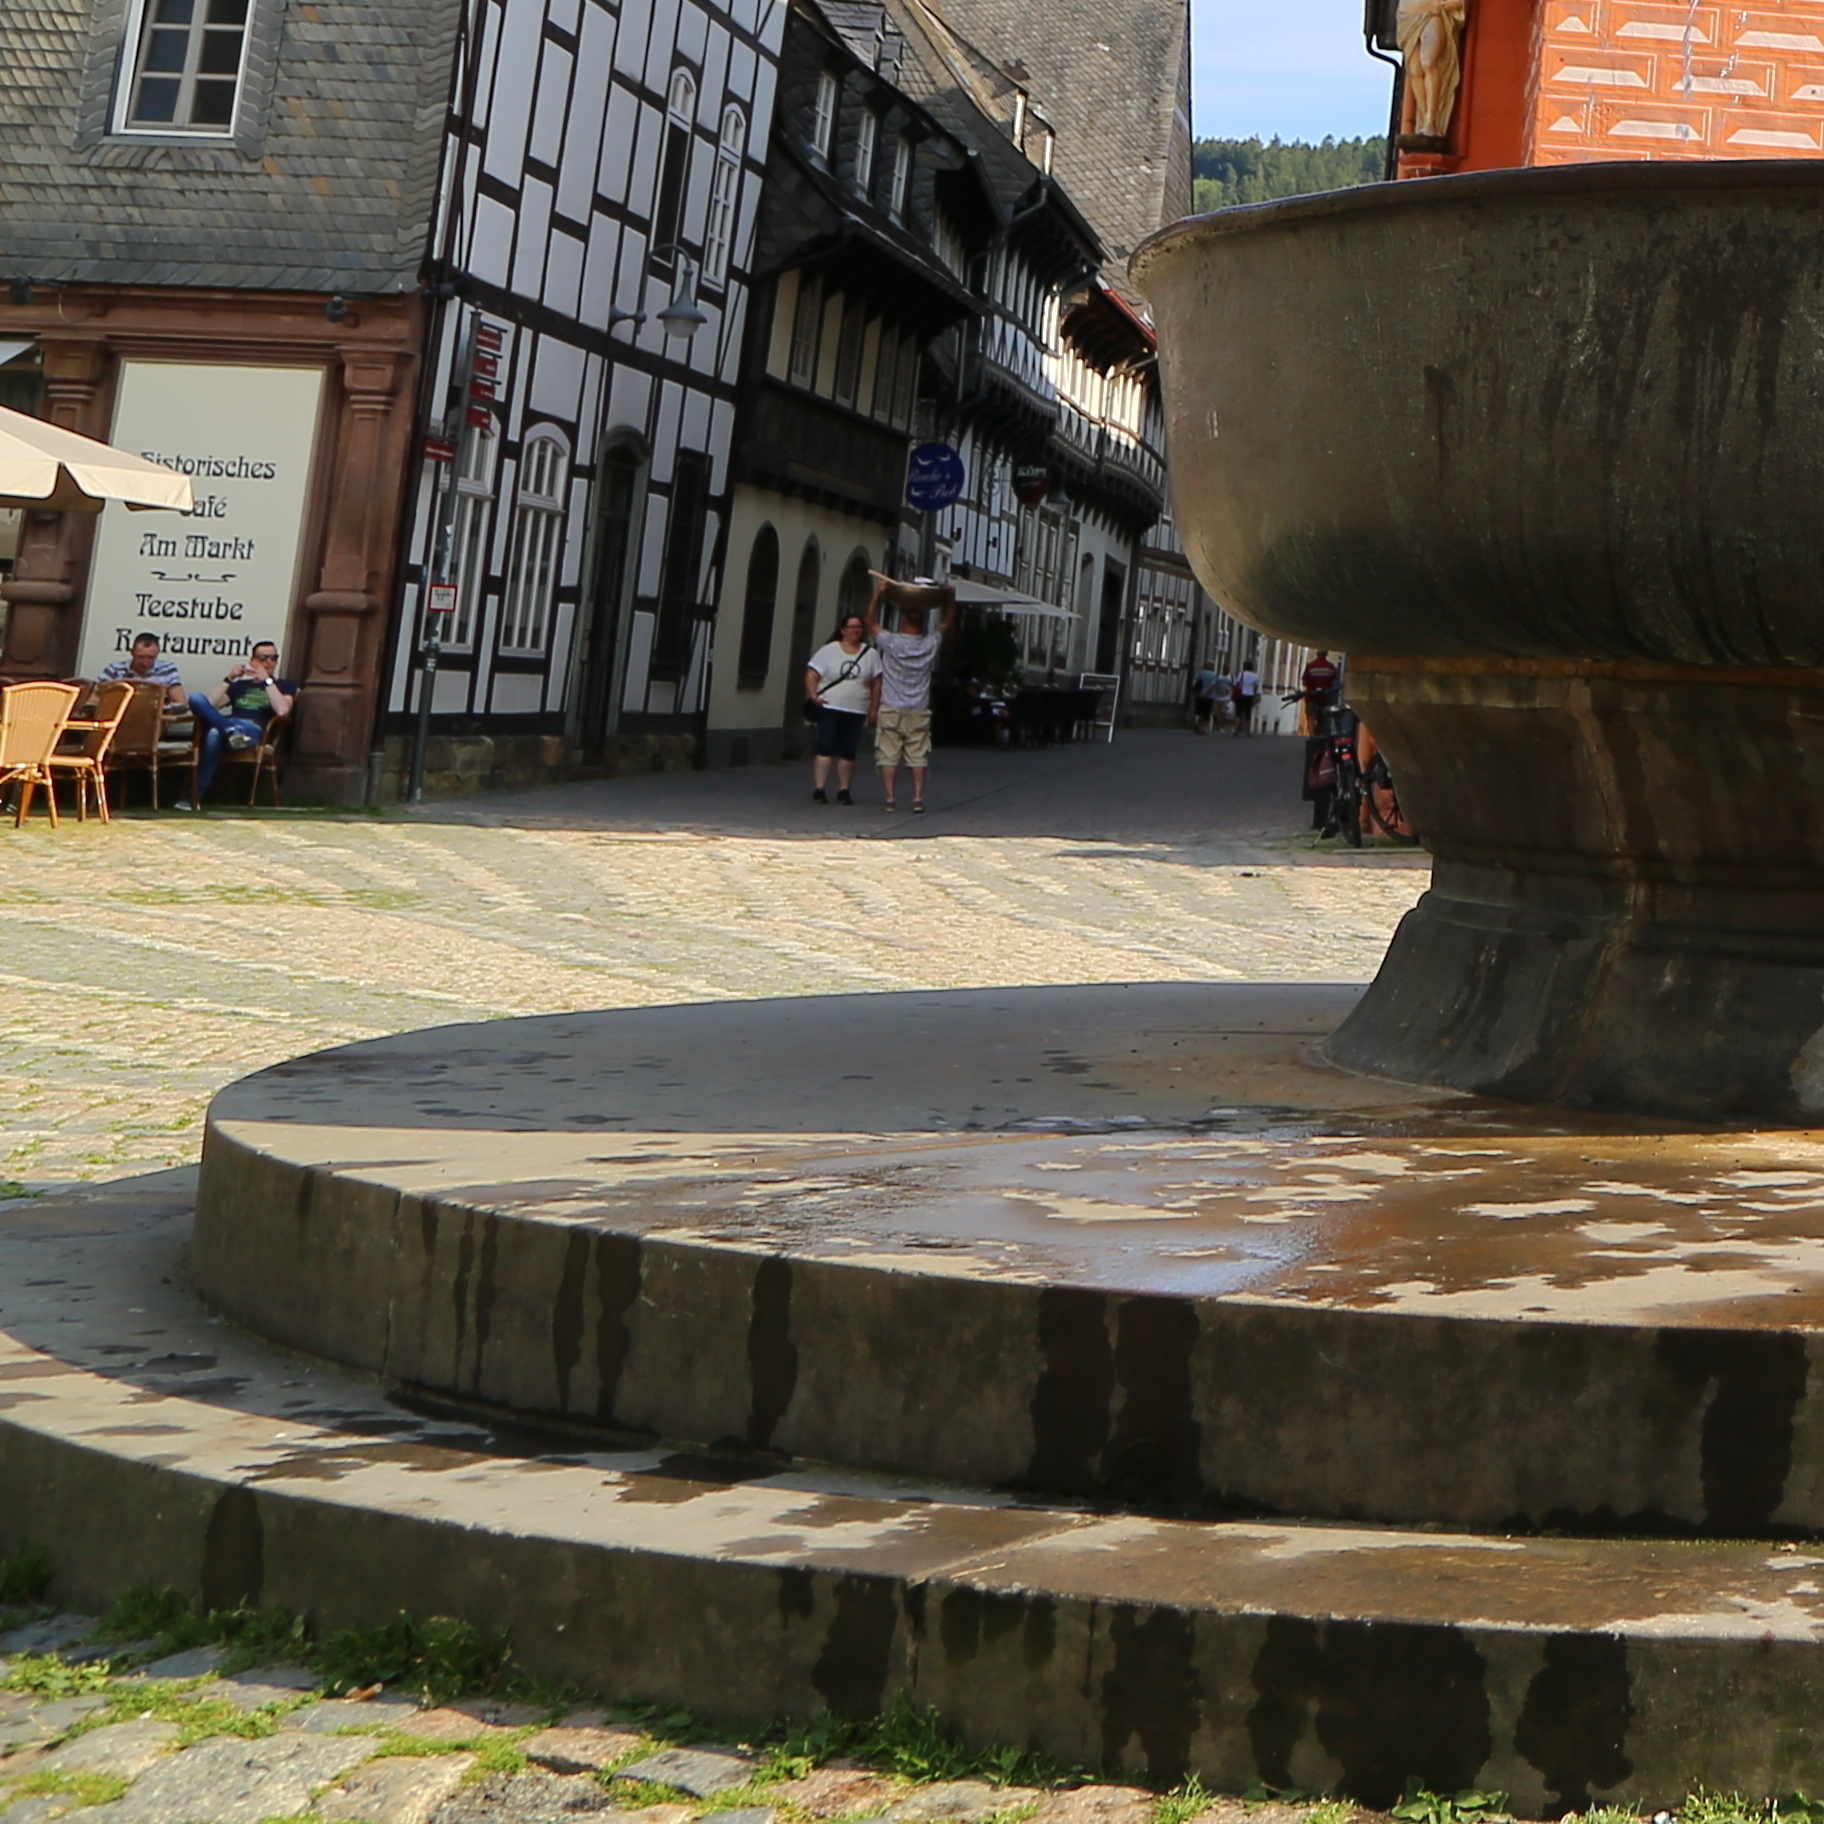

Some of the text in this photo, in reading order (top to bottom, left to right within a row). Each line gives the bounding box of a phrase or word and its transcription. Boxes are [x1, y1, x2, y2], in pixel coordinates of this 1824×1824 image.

[180, 495, 228, 518] afé
[139, 533, 255, 560] Am Markt
[136, 593, 244, 620] Teestube
[114, 628, 252, 656] Rtaurant
